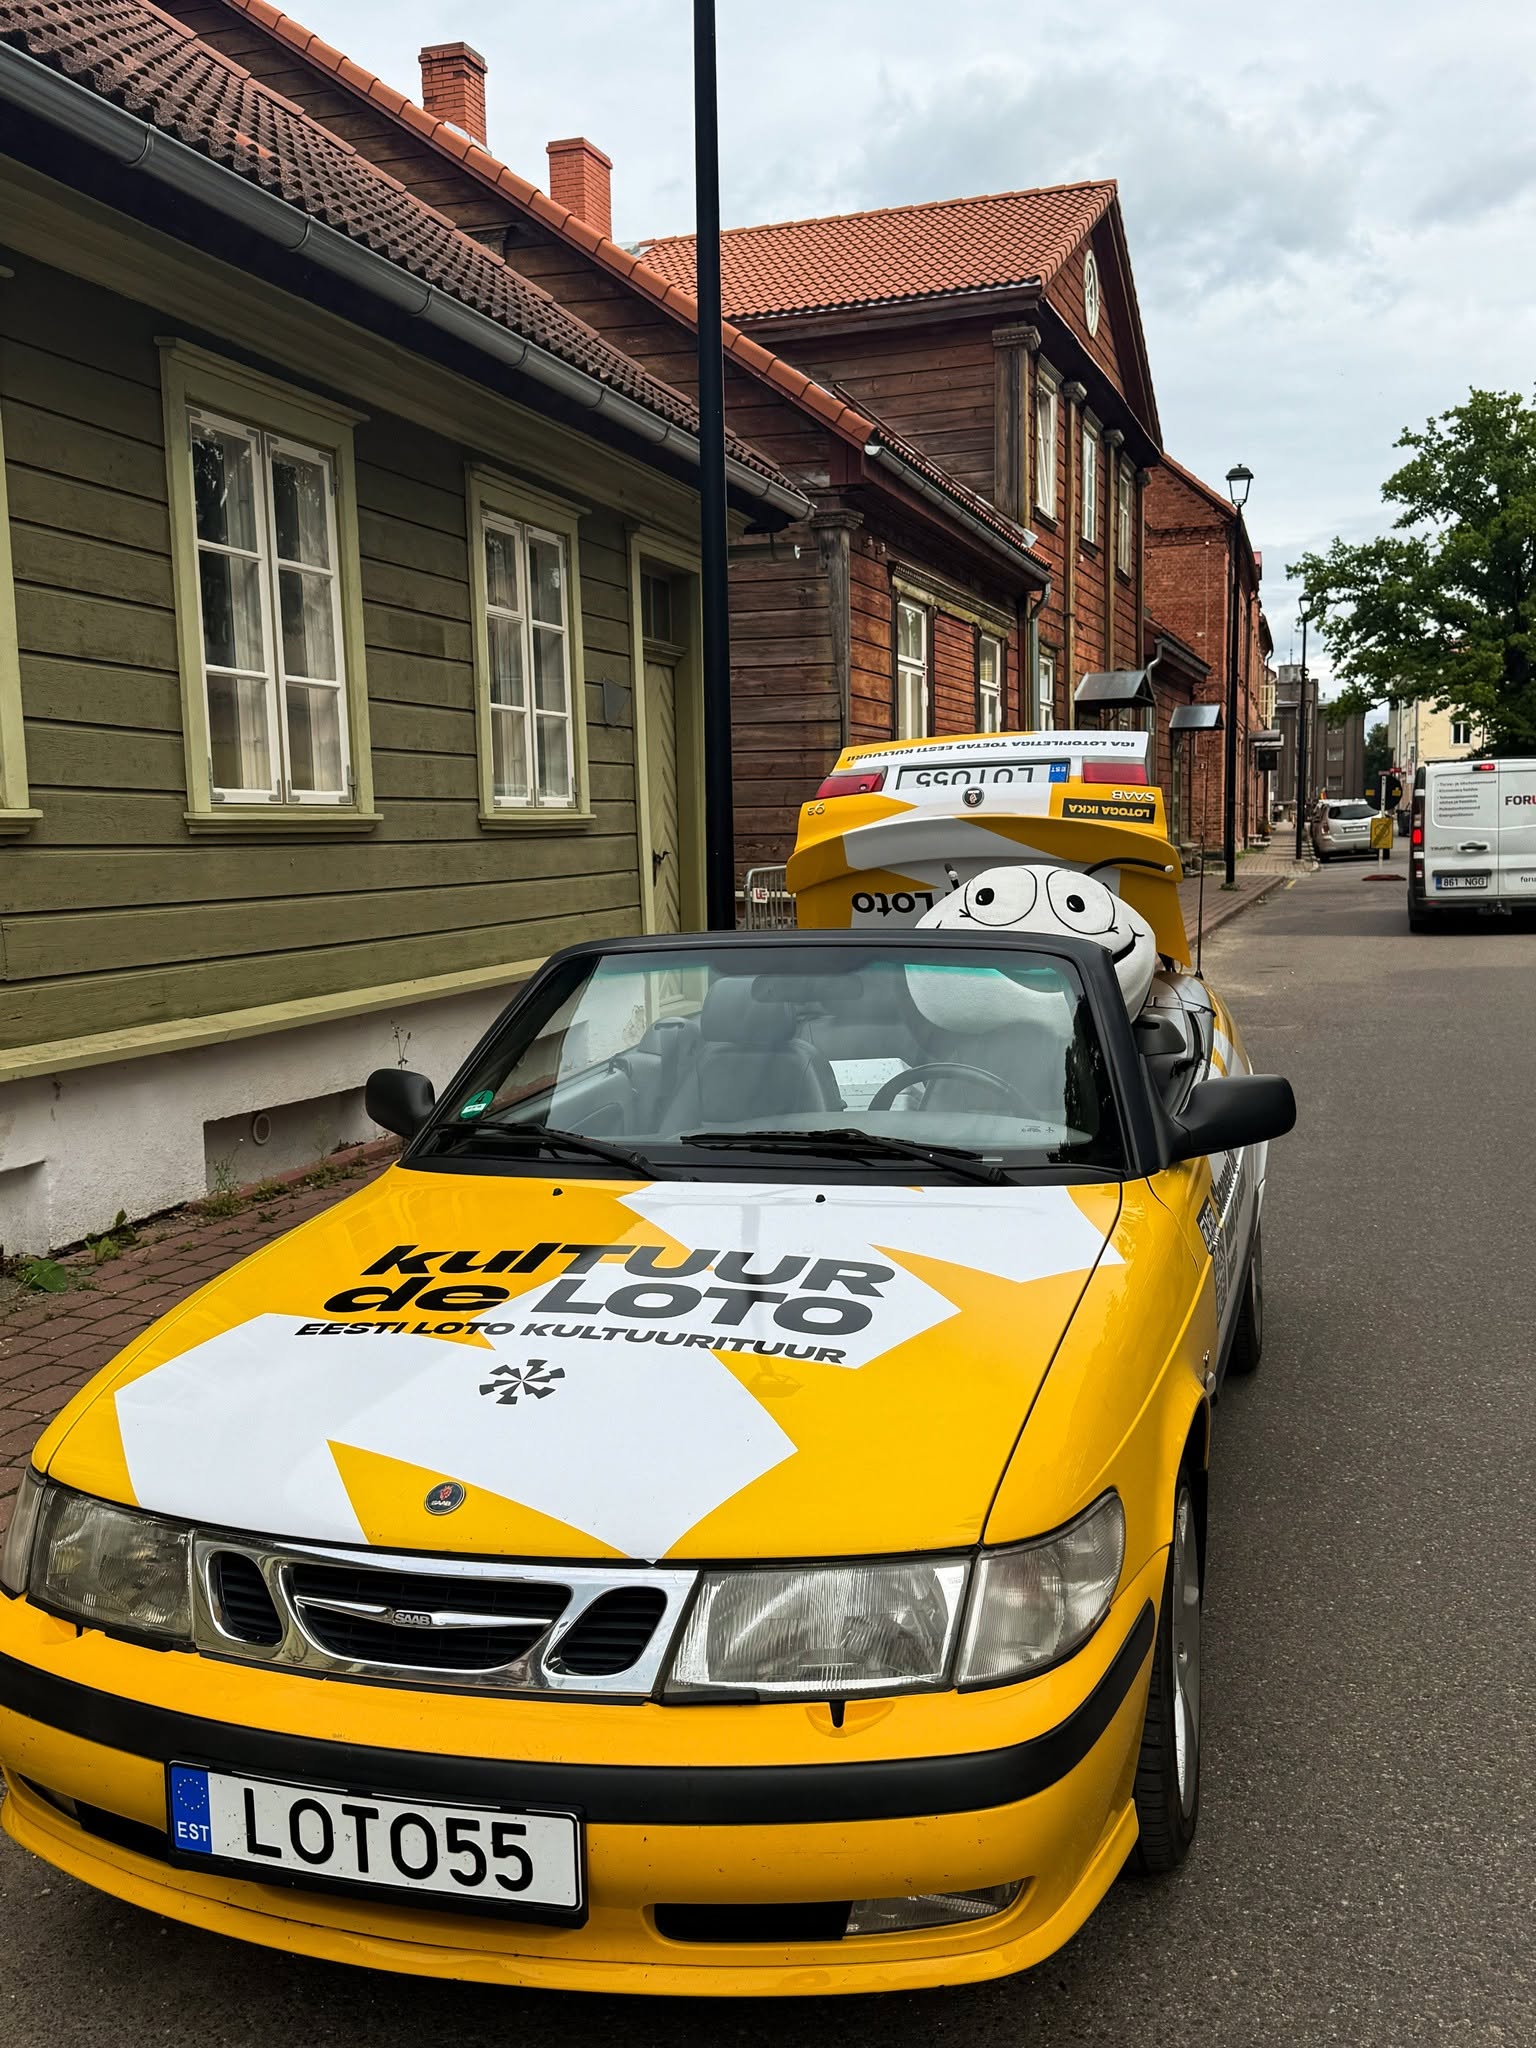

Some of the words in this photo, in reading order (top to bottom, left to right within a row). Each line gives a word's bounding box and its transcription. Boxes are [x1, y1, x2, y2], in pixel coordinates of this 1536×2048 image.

[917, 745, 953, 753] EESTI
[956, 741, 1007, 750] TOETAD
[1112, 790, 1155, 801] SAAB
[1068, 804, 1099, 814] IKKA
[1102, 806, 1150, 818] LOTOGA
[852, 892, 934, 917] Loto
[360, 1242, 896, 1298] kulTUUR
[323, 1276, 510, 1313] de
[530, 1278, 873, 1336] LOTO
[294, 1321, 408, 1335] EESTI
[411, 1321, 515, 1335] LOTO
[519, 1323, 847, 1364] KULTUURITUUR
[394, 1612, 431, 1626] SAAB
[177, 1821, 209, 1842] EST
[243, 1787, 534, 1892] LOTO55
